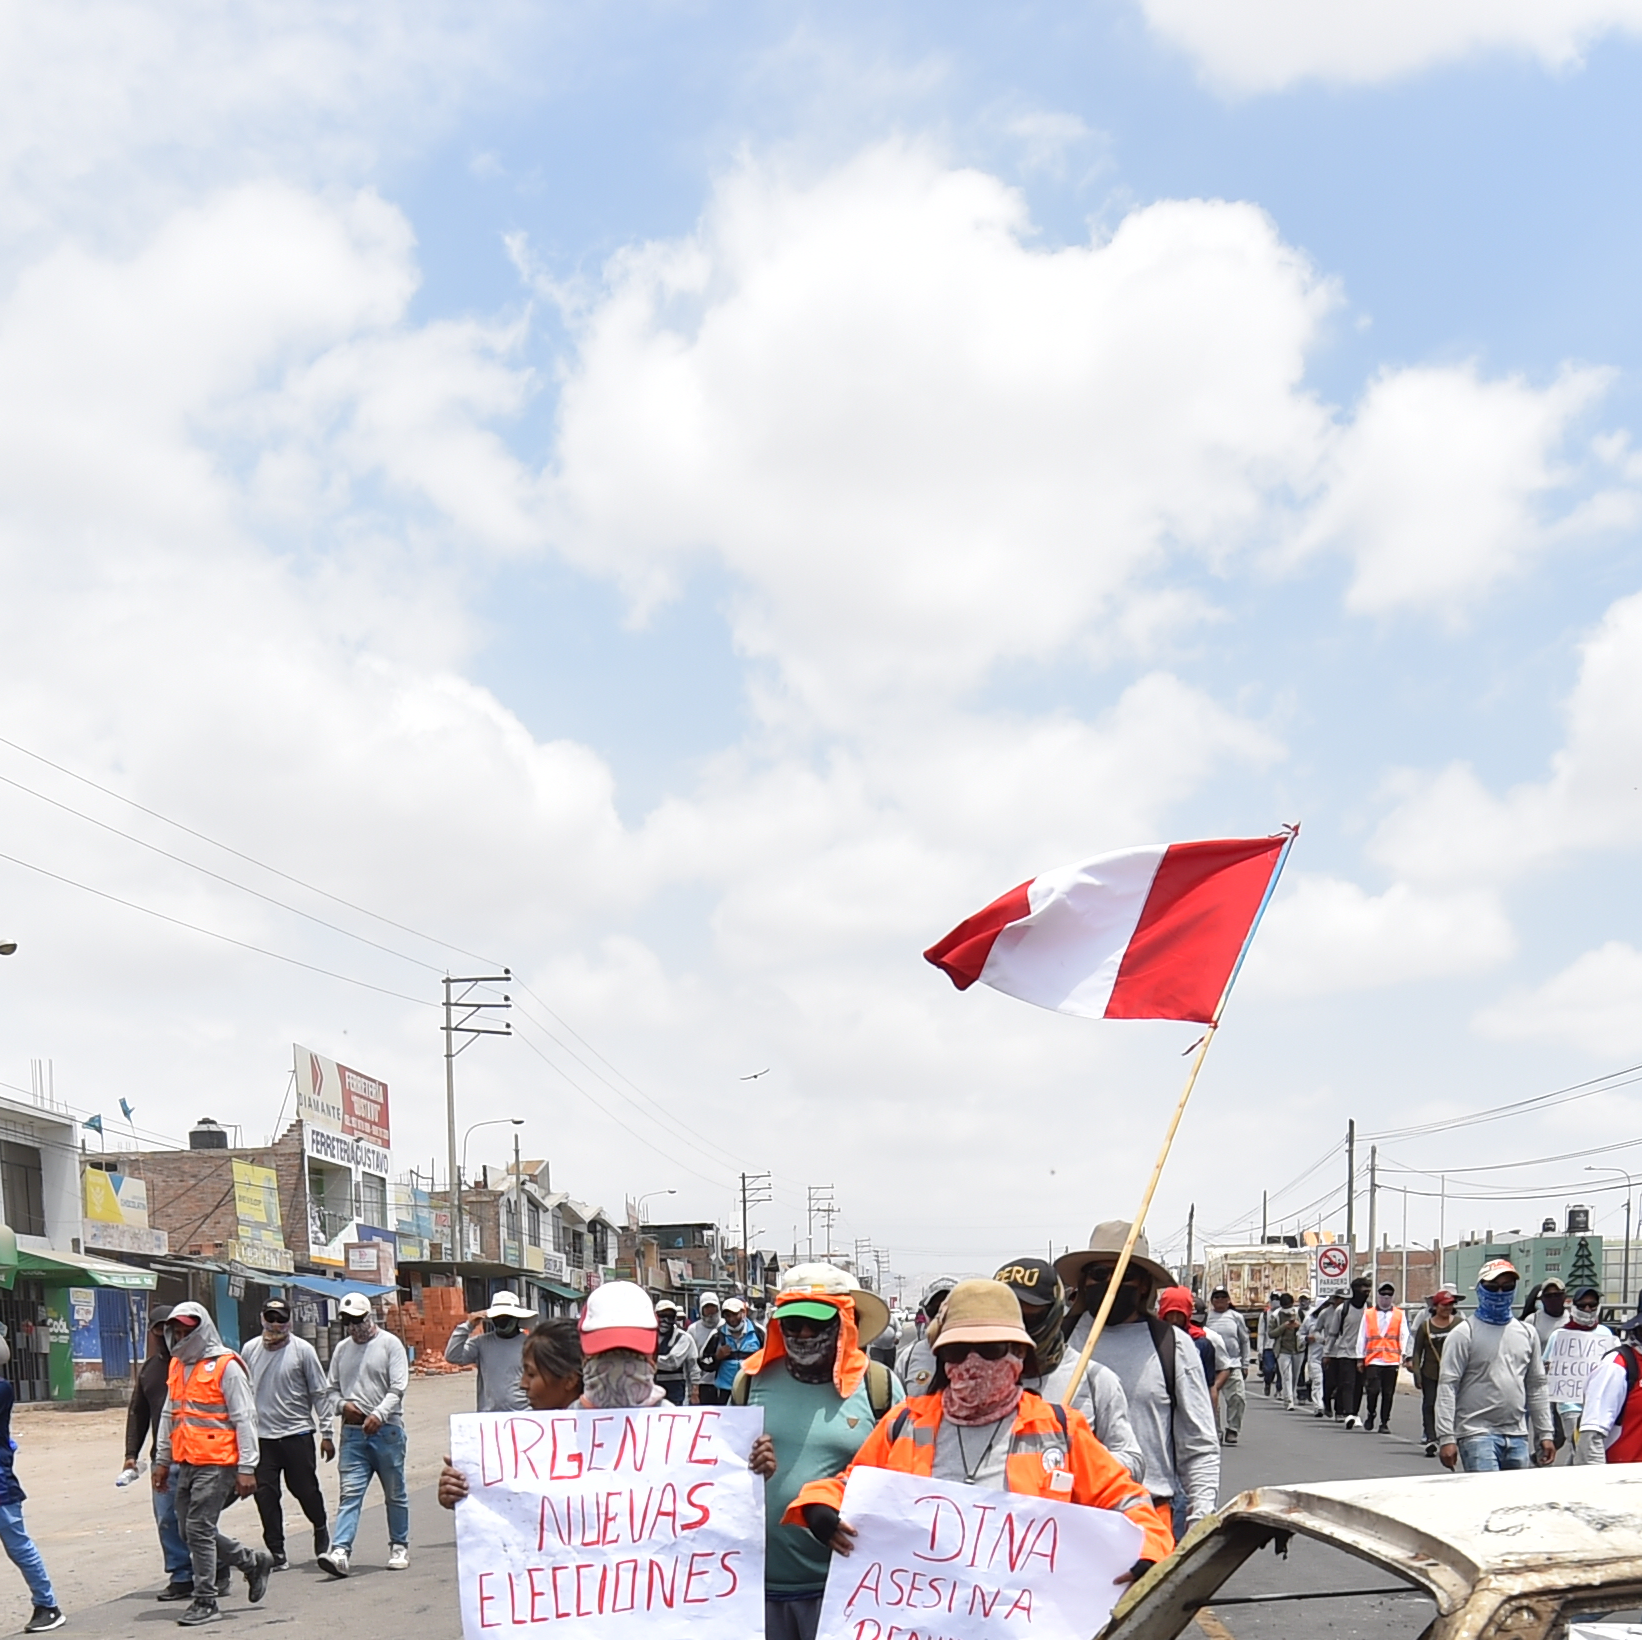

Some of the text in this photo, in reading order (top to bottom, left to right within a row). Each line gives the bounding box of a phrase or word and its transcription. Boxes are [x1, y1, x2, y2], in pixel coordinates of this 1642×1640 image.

[298, 1092, 341, 1121] DIAMANTE
[311, 1128, 356, 1164] FERRETERIA
[355, 1144, 389, 1175] GUSTAVO
[479, 1409, 721, 1488] URGENTE
[537, 1480, 714, 1552] NUEVAS
[912, 1494, 1060, 1573] DINA
[478, 1549, 740, 1629] ELECCIONES
[847, 1562, 1033, 1624] ASESINA
